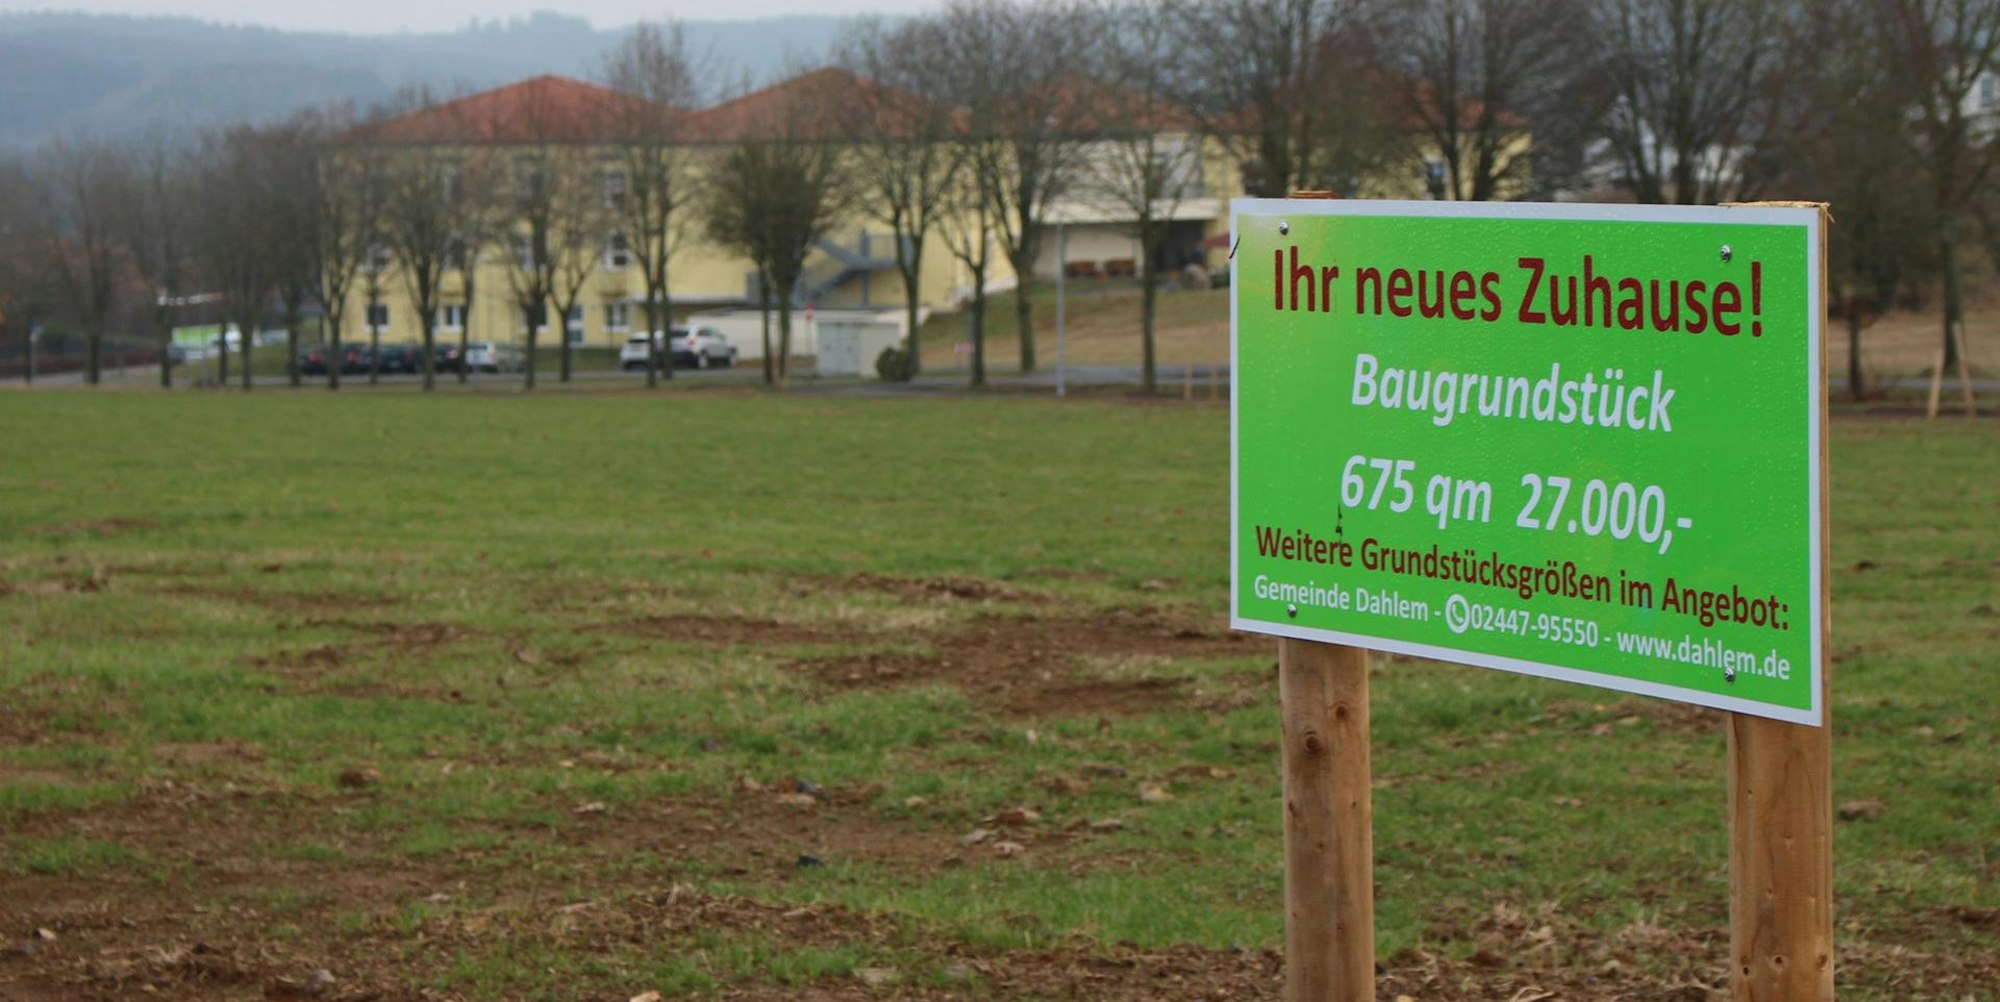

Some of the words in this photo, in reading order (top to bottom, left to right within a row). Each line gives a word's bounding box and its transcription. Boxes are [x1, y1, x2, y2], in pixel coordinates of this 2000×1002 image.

[1273, 246, 1339, 313] Ihr
[1355, 265, 1502, 323] neues
[1517, 254, 1763, 337] Zuhause!
[1351, 353, 1675, 432] Baugrundstück
[1340, 454, 1415, 512] 675
[1426, 472, 1491, 529] qm
[1516, 473, 1692, 554] 27.000,-
[1253, 574, 1350, 611] Gemeinde
[1355, 592, 1428, 623] Dahlem
[1470, 607, 1598, 648] 02447-95550
[1616, 630, 1791, 681] www.dahlem.de
[1255, 525, 1352, 567] Weitere
[1360, 538, 1610, 603] Grundstücksgrößen
[1619, 570, 1652, 610] im
[1661, 576, 1789, 631] Angebot:
